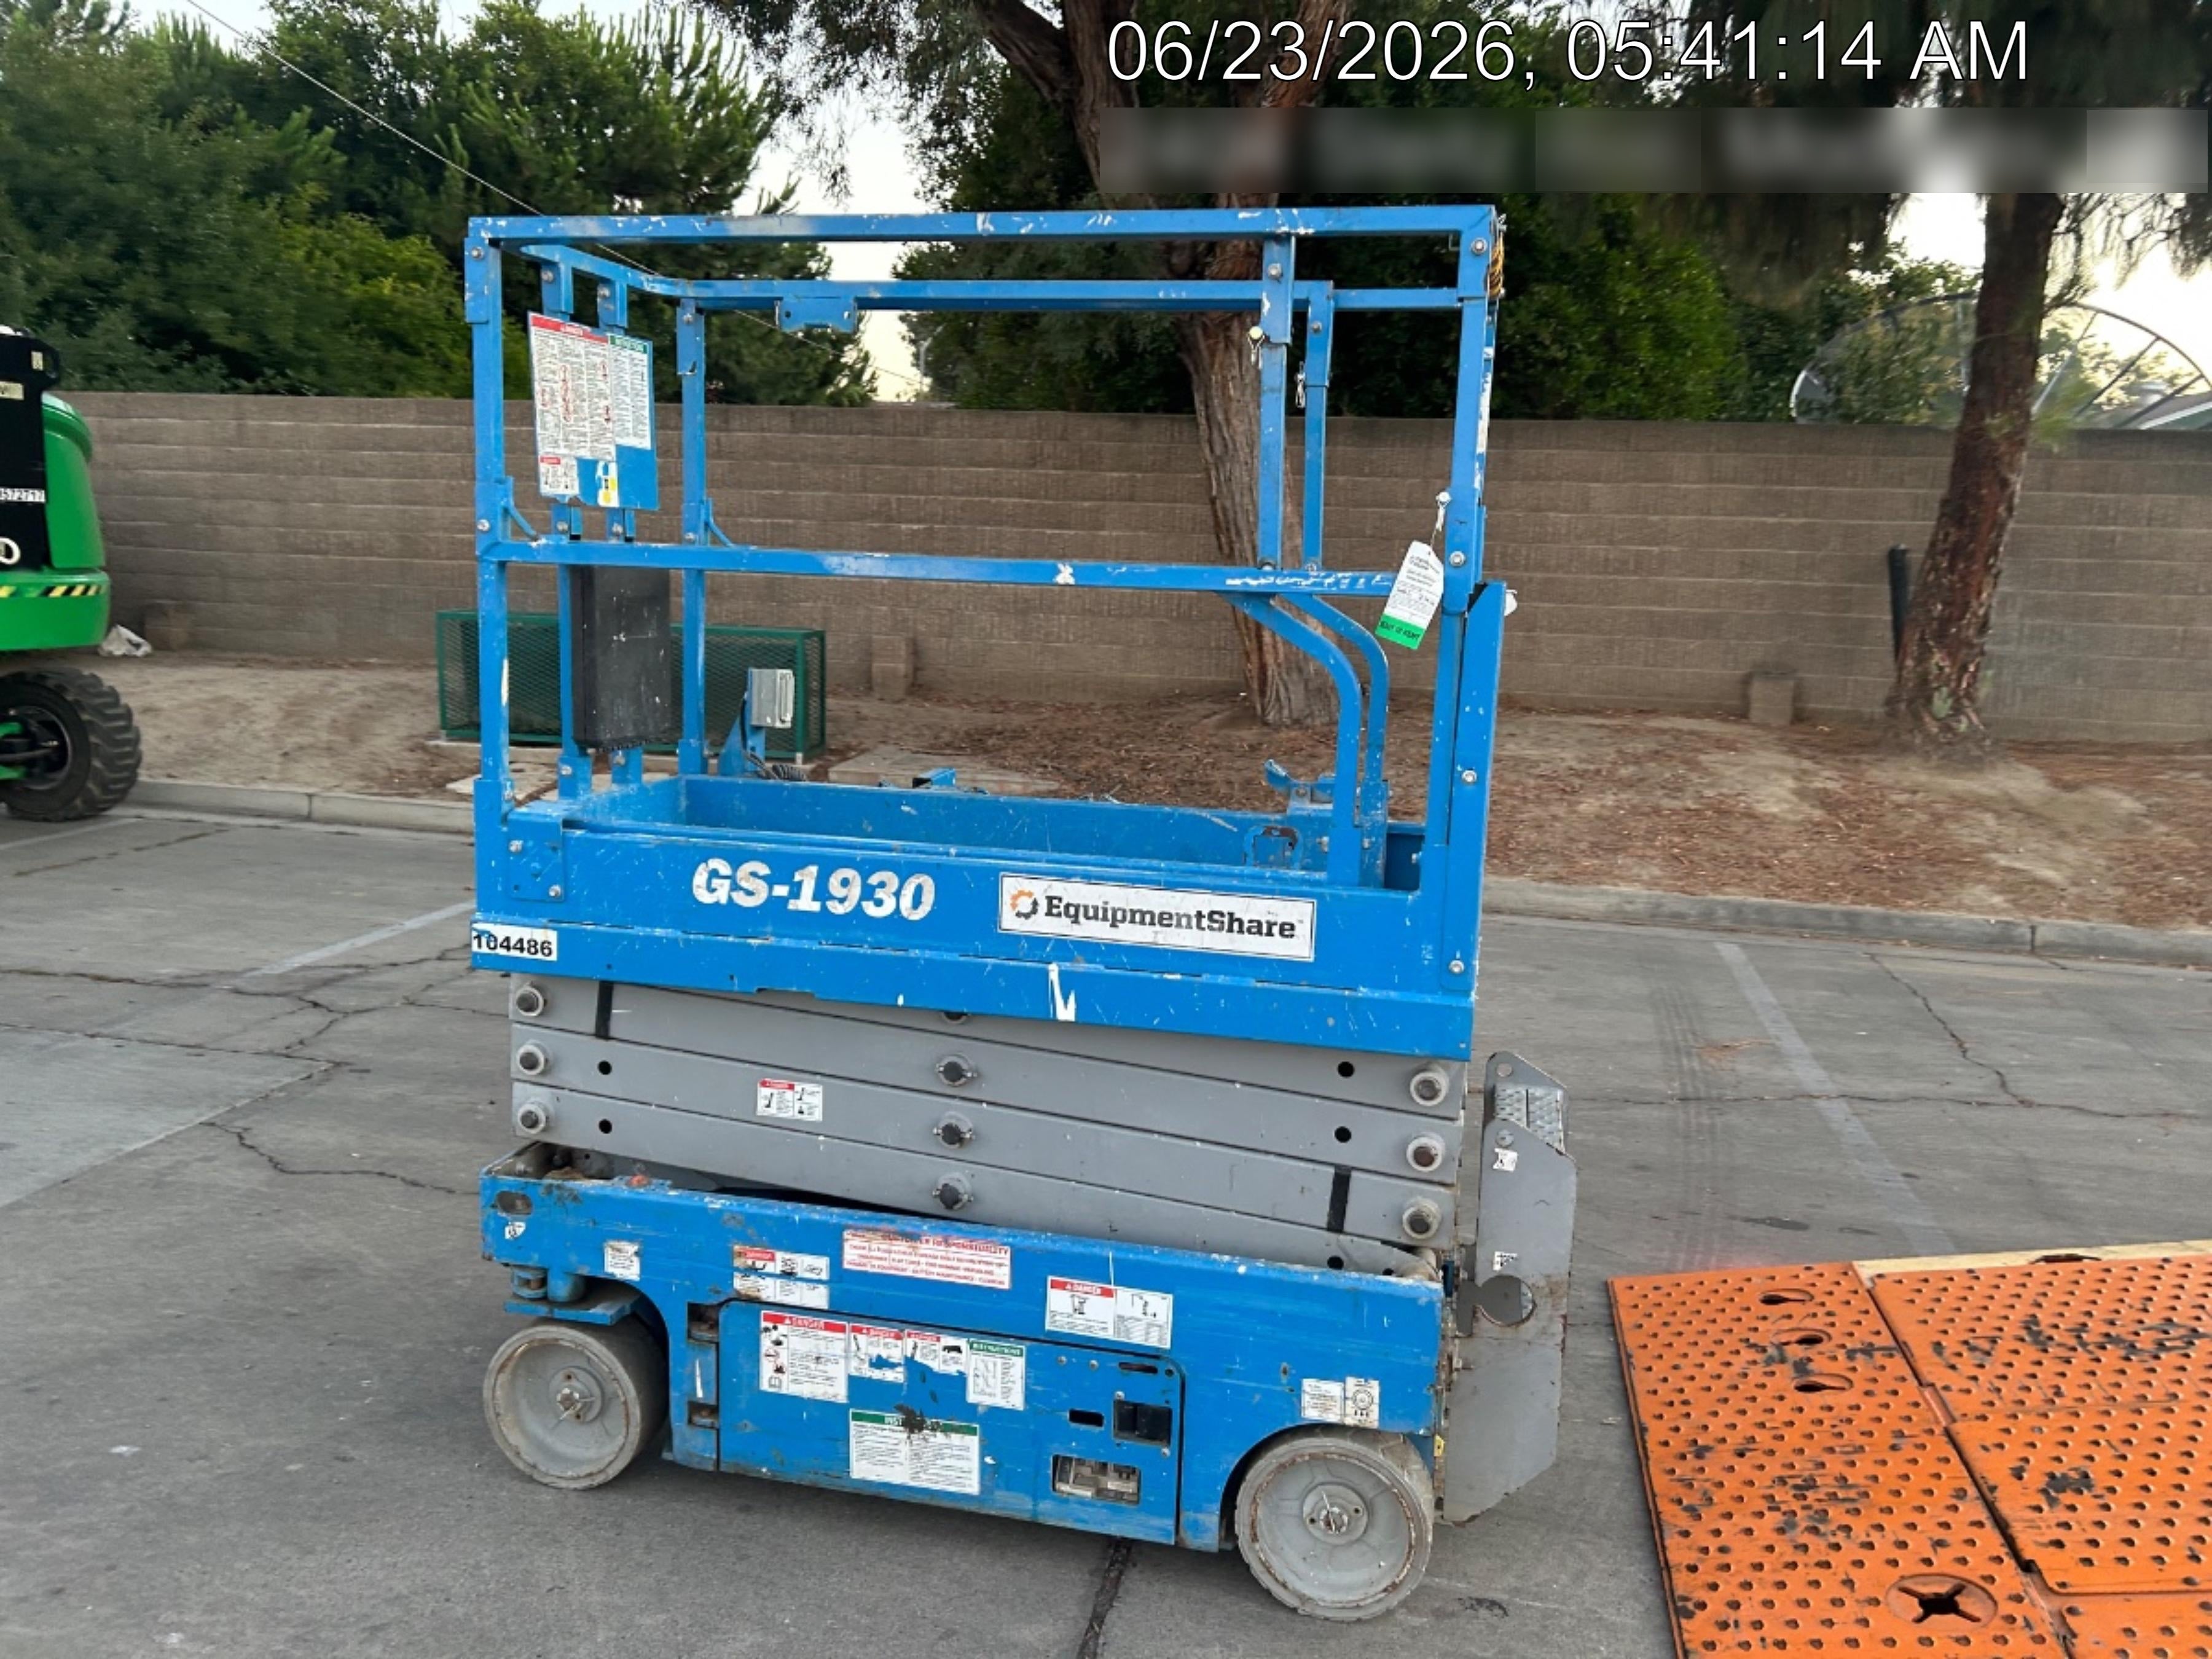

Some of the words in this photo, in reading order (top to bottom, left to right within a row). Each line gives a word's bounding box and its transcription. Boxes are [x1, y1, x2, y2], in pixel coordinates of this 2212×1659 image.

[692, 858, 935, 920] GS-1930
[1045, 895, 1296, 939] EquipmentShare
[473, 933, 553, 957] 104486
